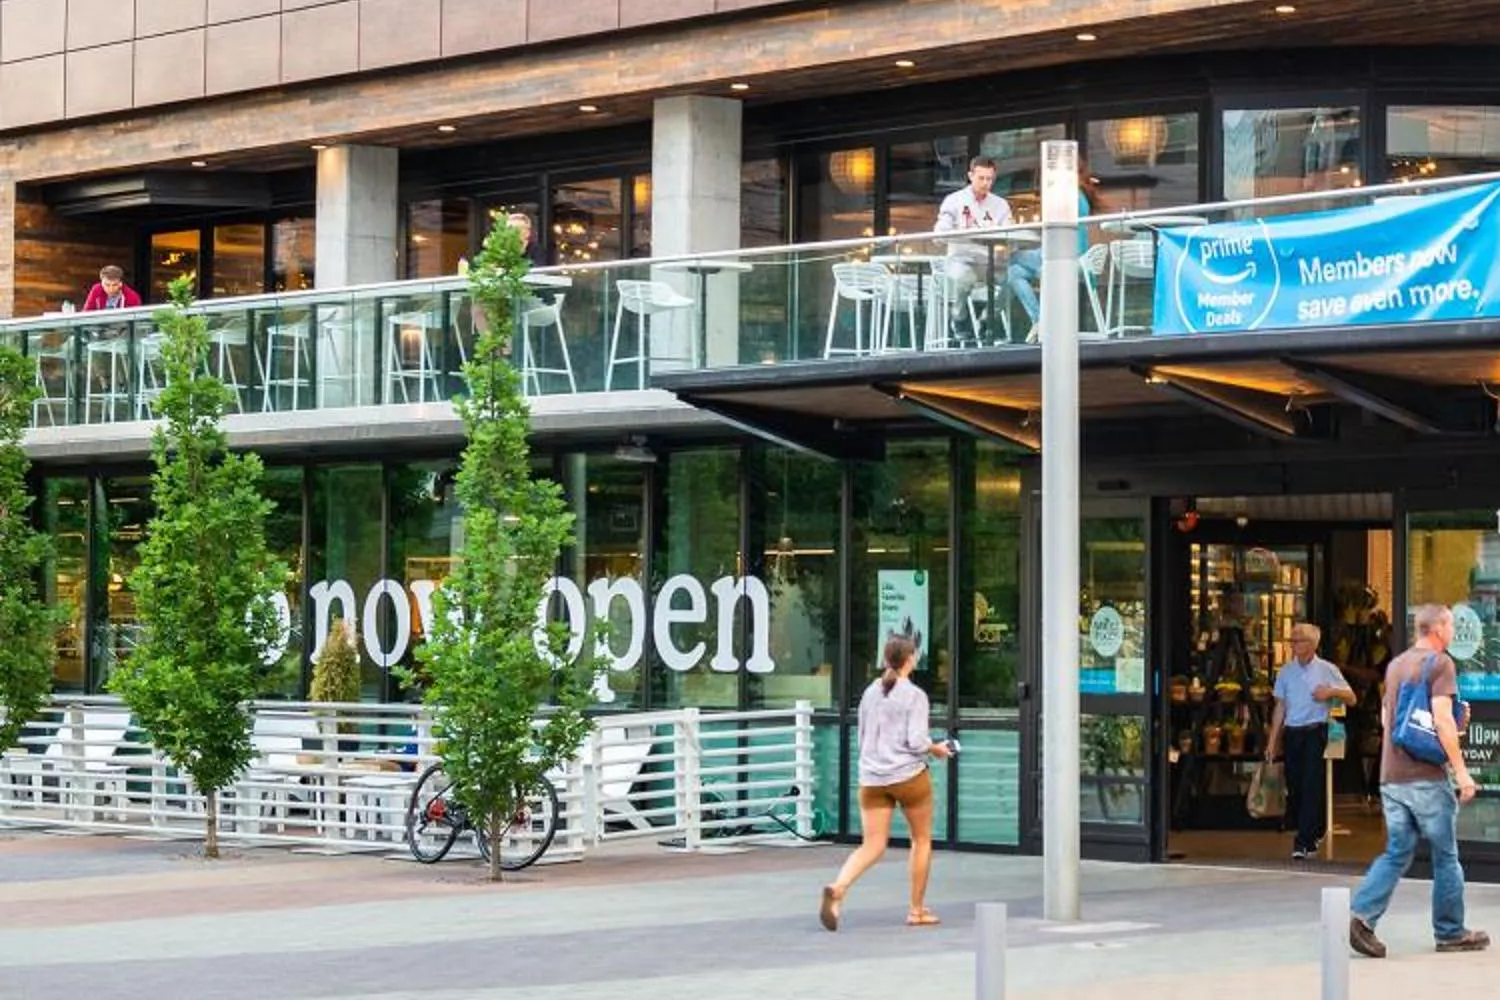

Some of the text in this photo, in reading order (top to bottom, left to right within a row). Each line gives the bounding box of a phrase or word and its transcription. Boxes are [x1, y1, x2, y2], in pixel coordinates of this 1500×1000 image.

[1200, 234, 1253, 265] prime
[1298, 250, 1401, 287] Members
[1197, 290, 1255, 308] Member
[1297, 298, 1346, 321] save
[1409, 278, 1480, 306] more.
[1206, 309, 1243, 328] Deals
[533, 573, 776, 703] open
[1469, 723, 1500, 745] 10PM
